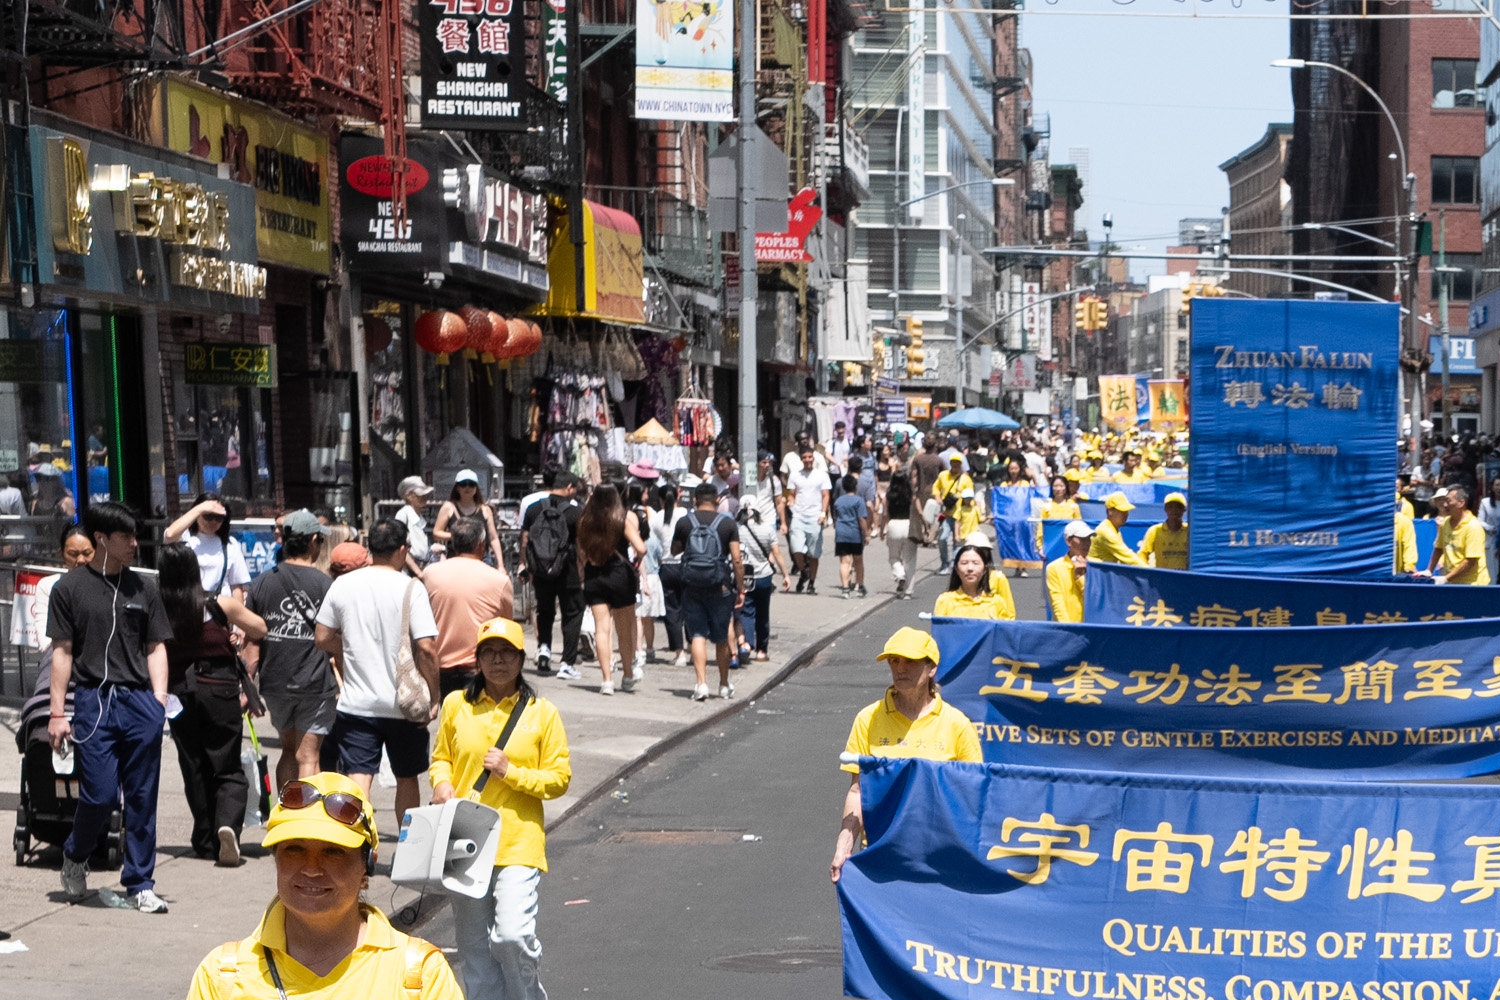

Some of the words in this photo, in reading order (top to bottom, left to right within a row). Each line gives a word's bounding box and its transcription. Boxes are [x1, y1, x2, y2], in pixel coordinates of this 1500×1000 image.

[436, 18, 510, 55] 餐館
[456, 62, 487, 78] NEW
[436, 80, 508, 98] SHANGHAI
[427, 99, 521, 117] RESTAURANT
[637, 99, 733, 115] WWW.CHINATOWN.NYC
[357, 241, 387, 253] SHANGHAI
[755, 249, 804, 260] HARMACY
[1107, 384, 1130, 411] 法
[1223, 379, 1363, 410] 轉法輪
[1236, 444, 1287, 458] (English
[1290, 443, 1339, 457] Version)
[241, 541, 277, 557] LAY
[19, 583, 36, 595] PRI
[1026, 724, 1081, 746] SETS
[1086, 729, 1117, 748] OF
[1121, 729, 1215, 748] GENTLE
[1220, 729, 1343, 748] EXERCISES
[1348, 729, 1399, 746] AND
[1102, 918, 1307, 959] QUALITIES
[1315, 931, 1367, 959] OF
[1375, 932, 1453, 960] THE
